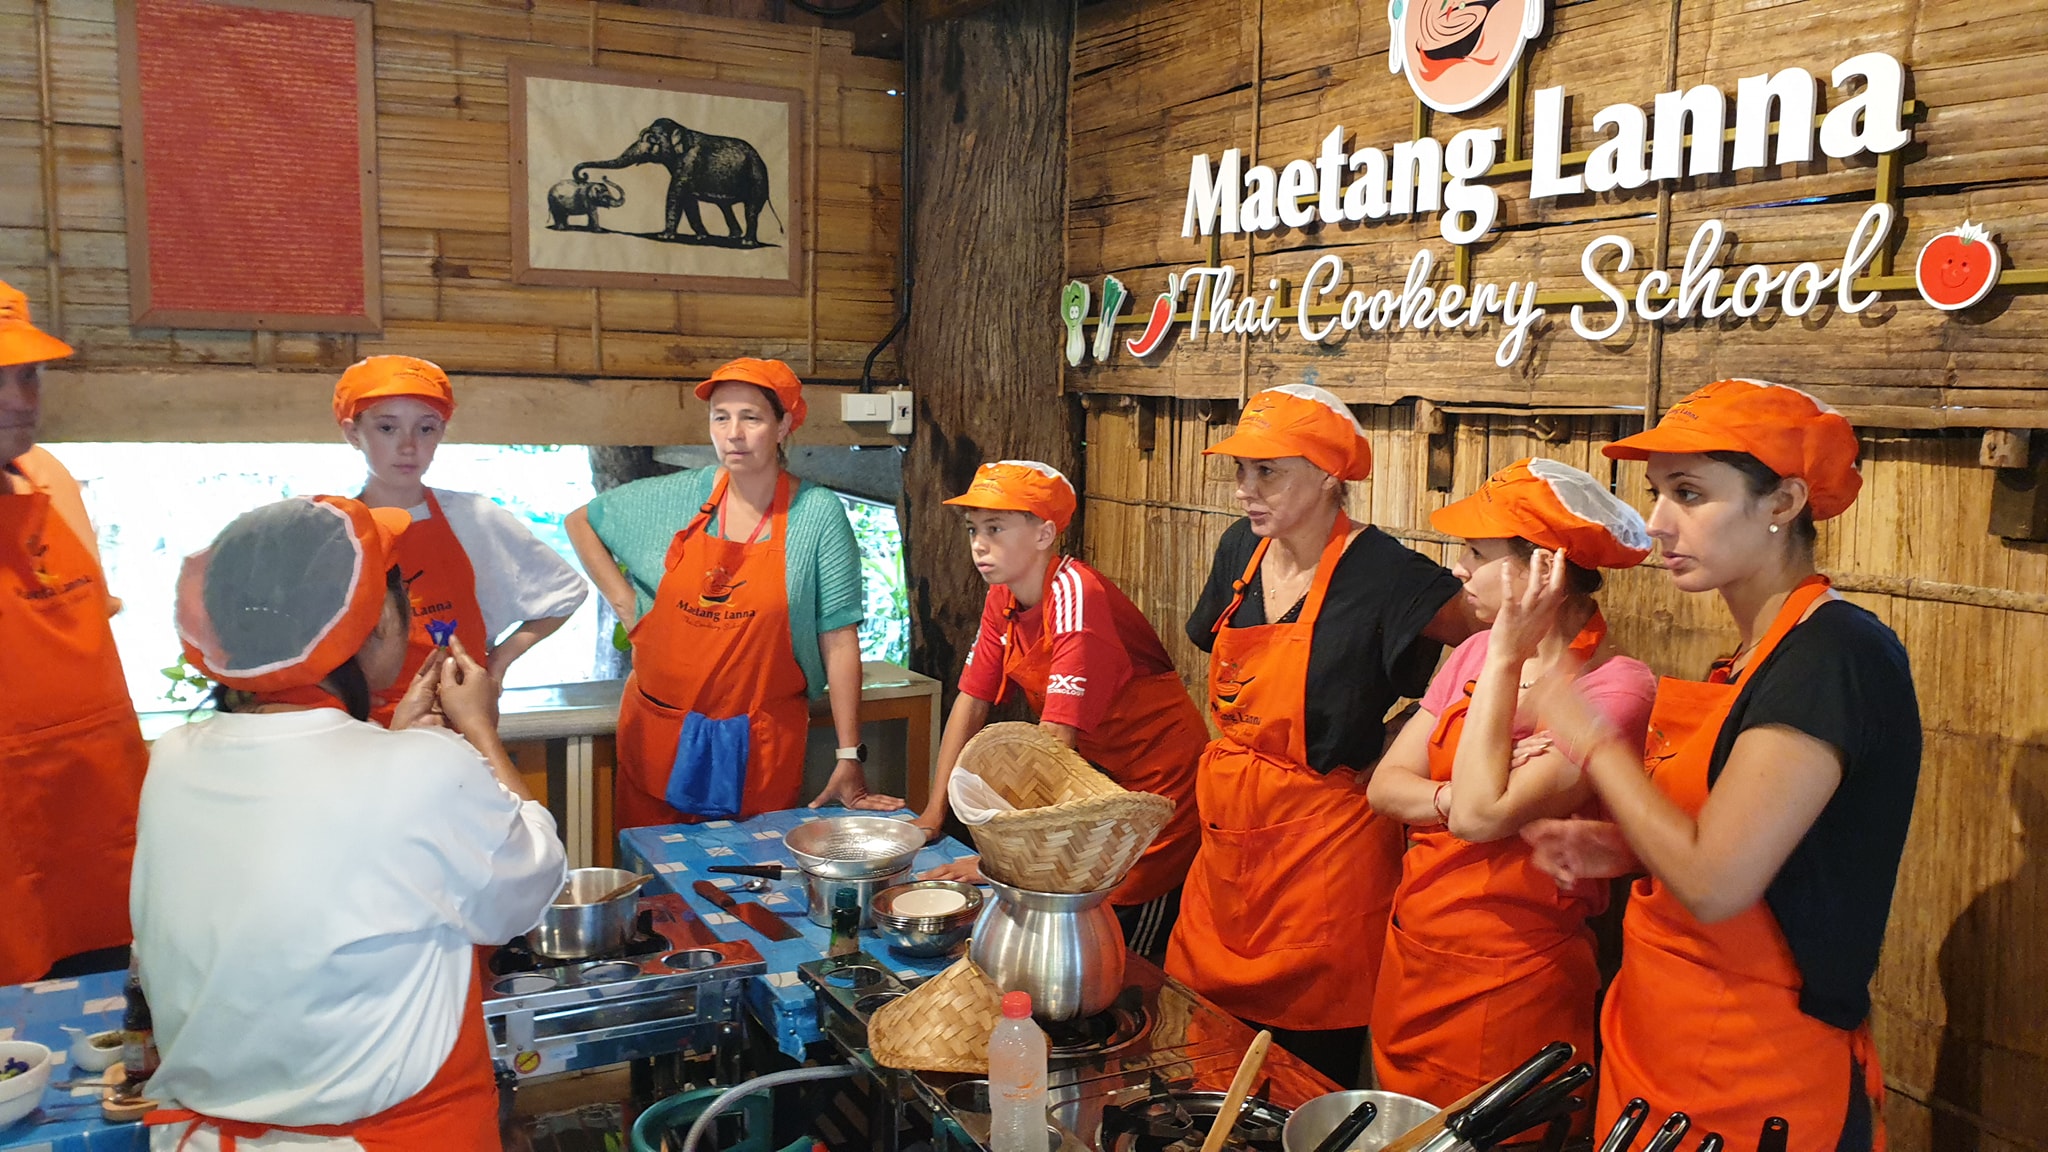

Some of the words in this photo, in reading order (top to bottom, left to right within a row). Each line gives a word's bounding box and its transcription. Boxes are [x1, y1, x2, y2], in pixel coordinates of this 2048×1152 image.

[1181, 124, 1502, 244] Maetang
[1529, 52, 1911, 199] Lanna
[1180, 265, 1281, 341] Thai
[1298, 248, 1546, 368] Cookery
[1569, 203, 1894, 341] School
[413, 601, 452, 617] Lanna
[676, 599, 721, 623] Maetang
[724, 609, 756, 620] Lanna
